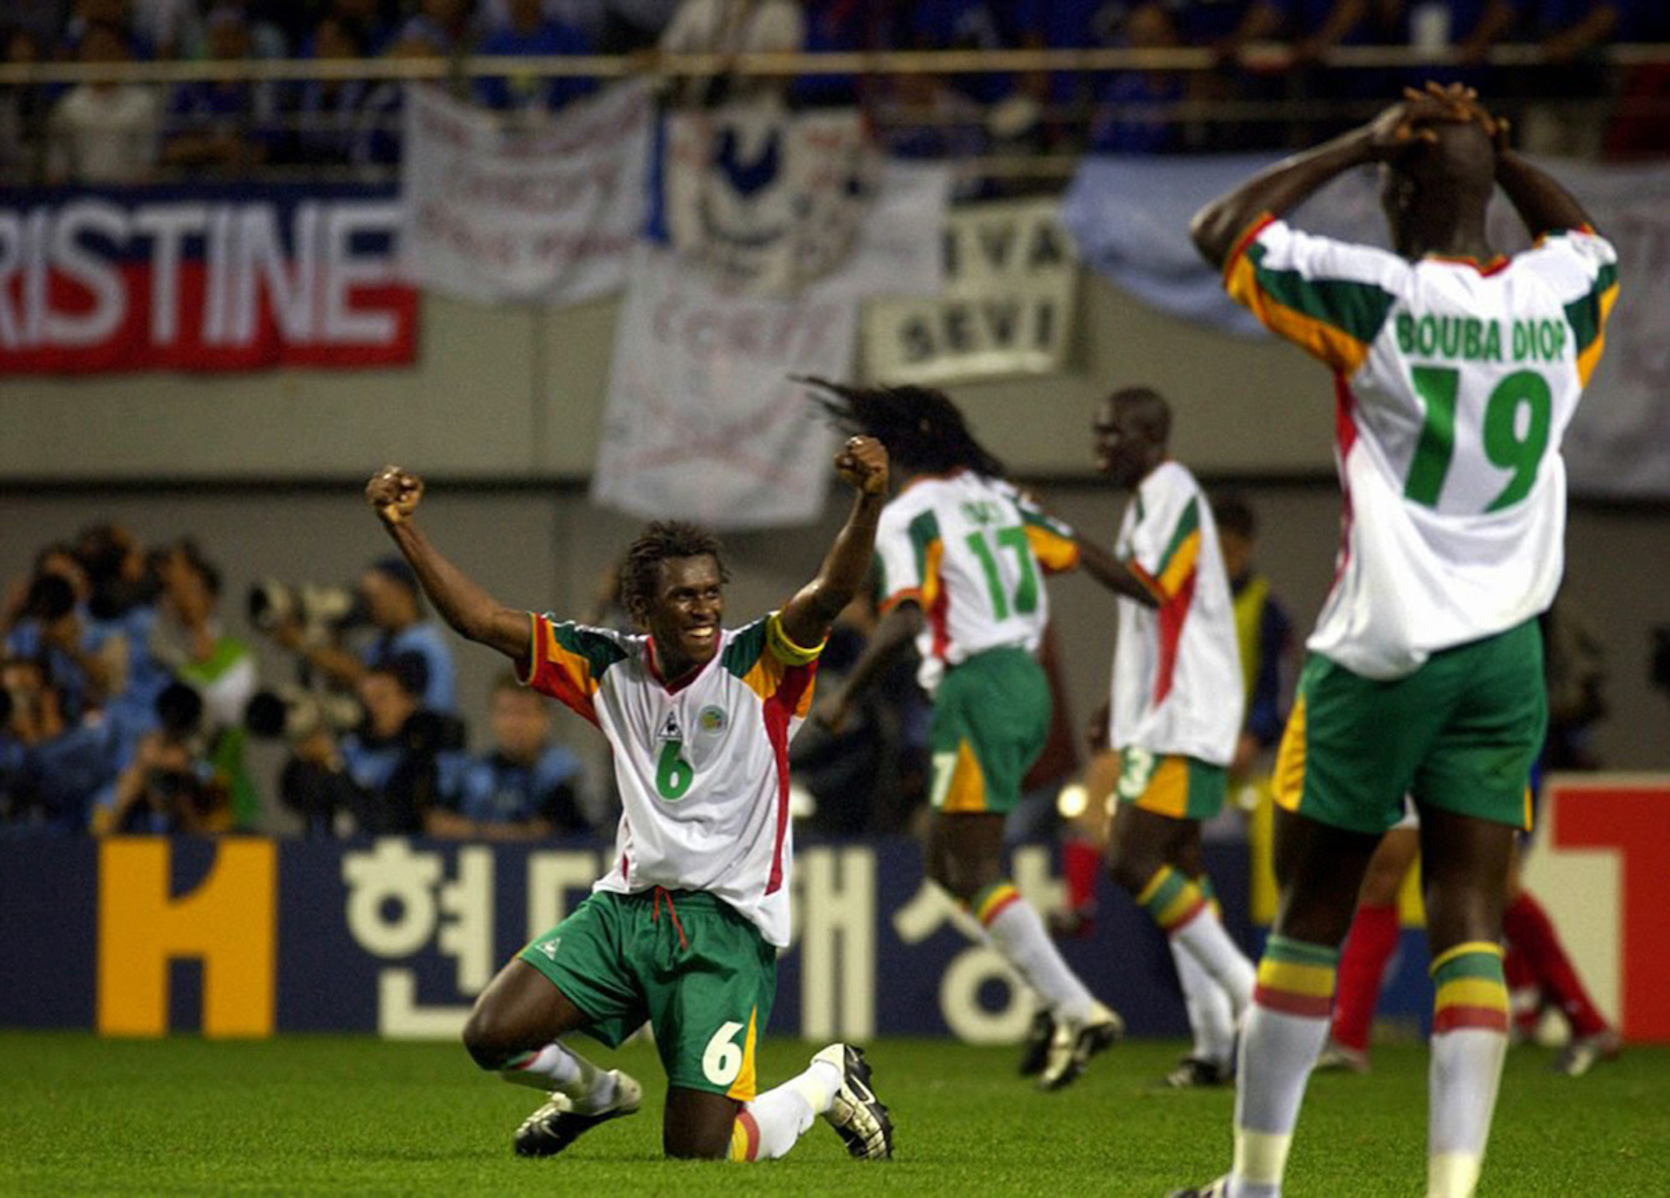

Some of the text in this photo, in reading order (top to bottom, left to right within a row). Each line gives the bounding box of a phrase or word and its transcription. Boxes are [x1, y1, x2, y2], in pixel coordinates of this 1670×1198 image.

[1396, 311, 1566, 362] BOUBA DIOP
[1404, 366, 1552, 514] 19
[965, 526, 1038, 622] 17
[656, 739, 694, 801] 6
[703, 1021, 743, 1086] 6
